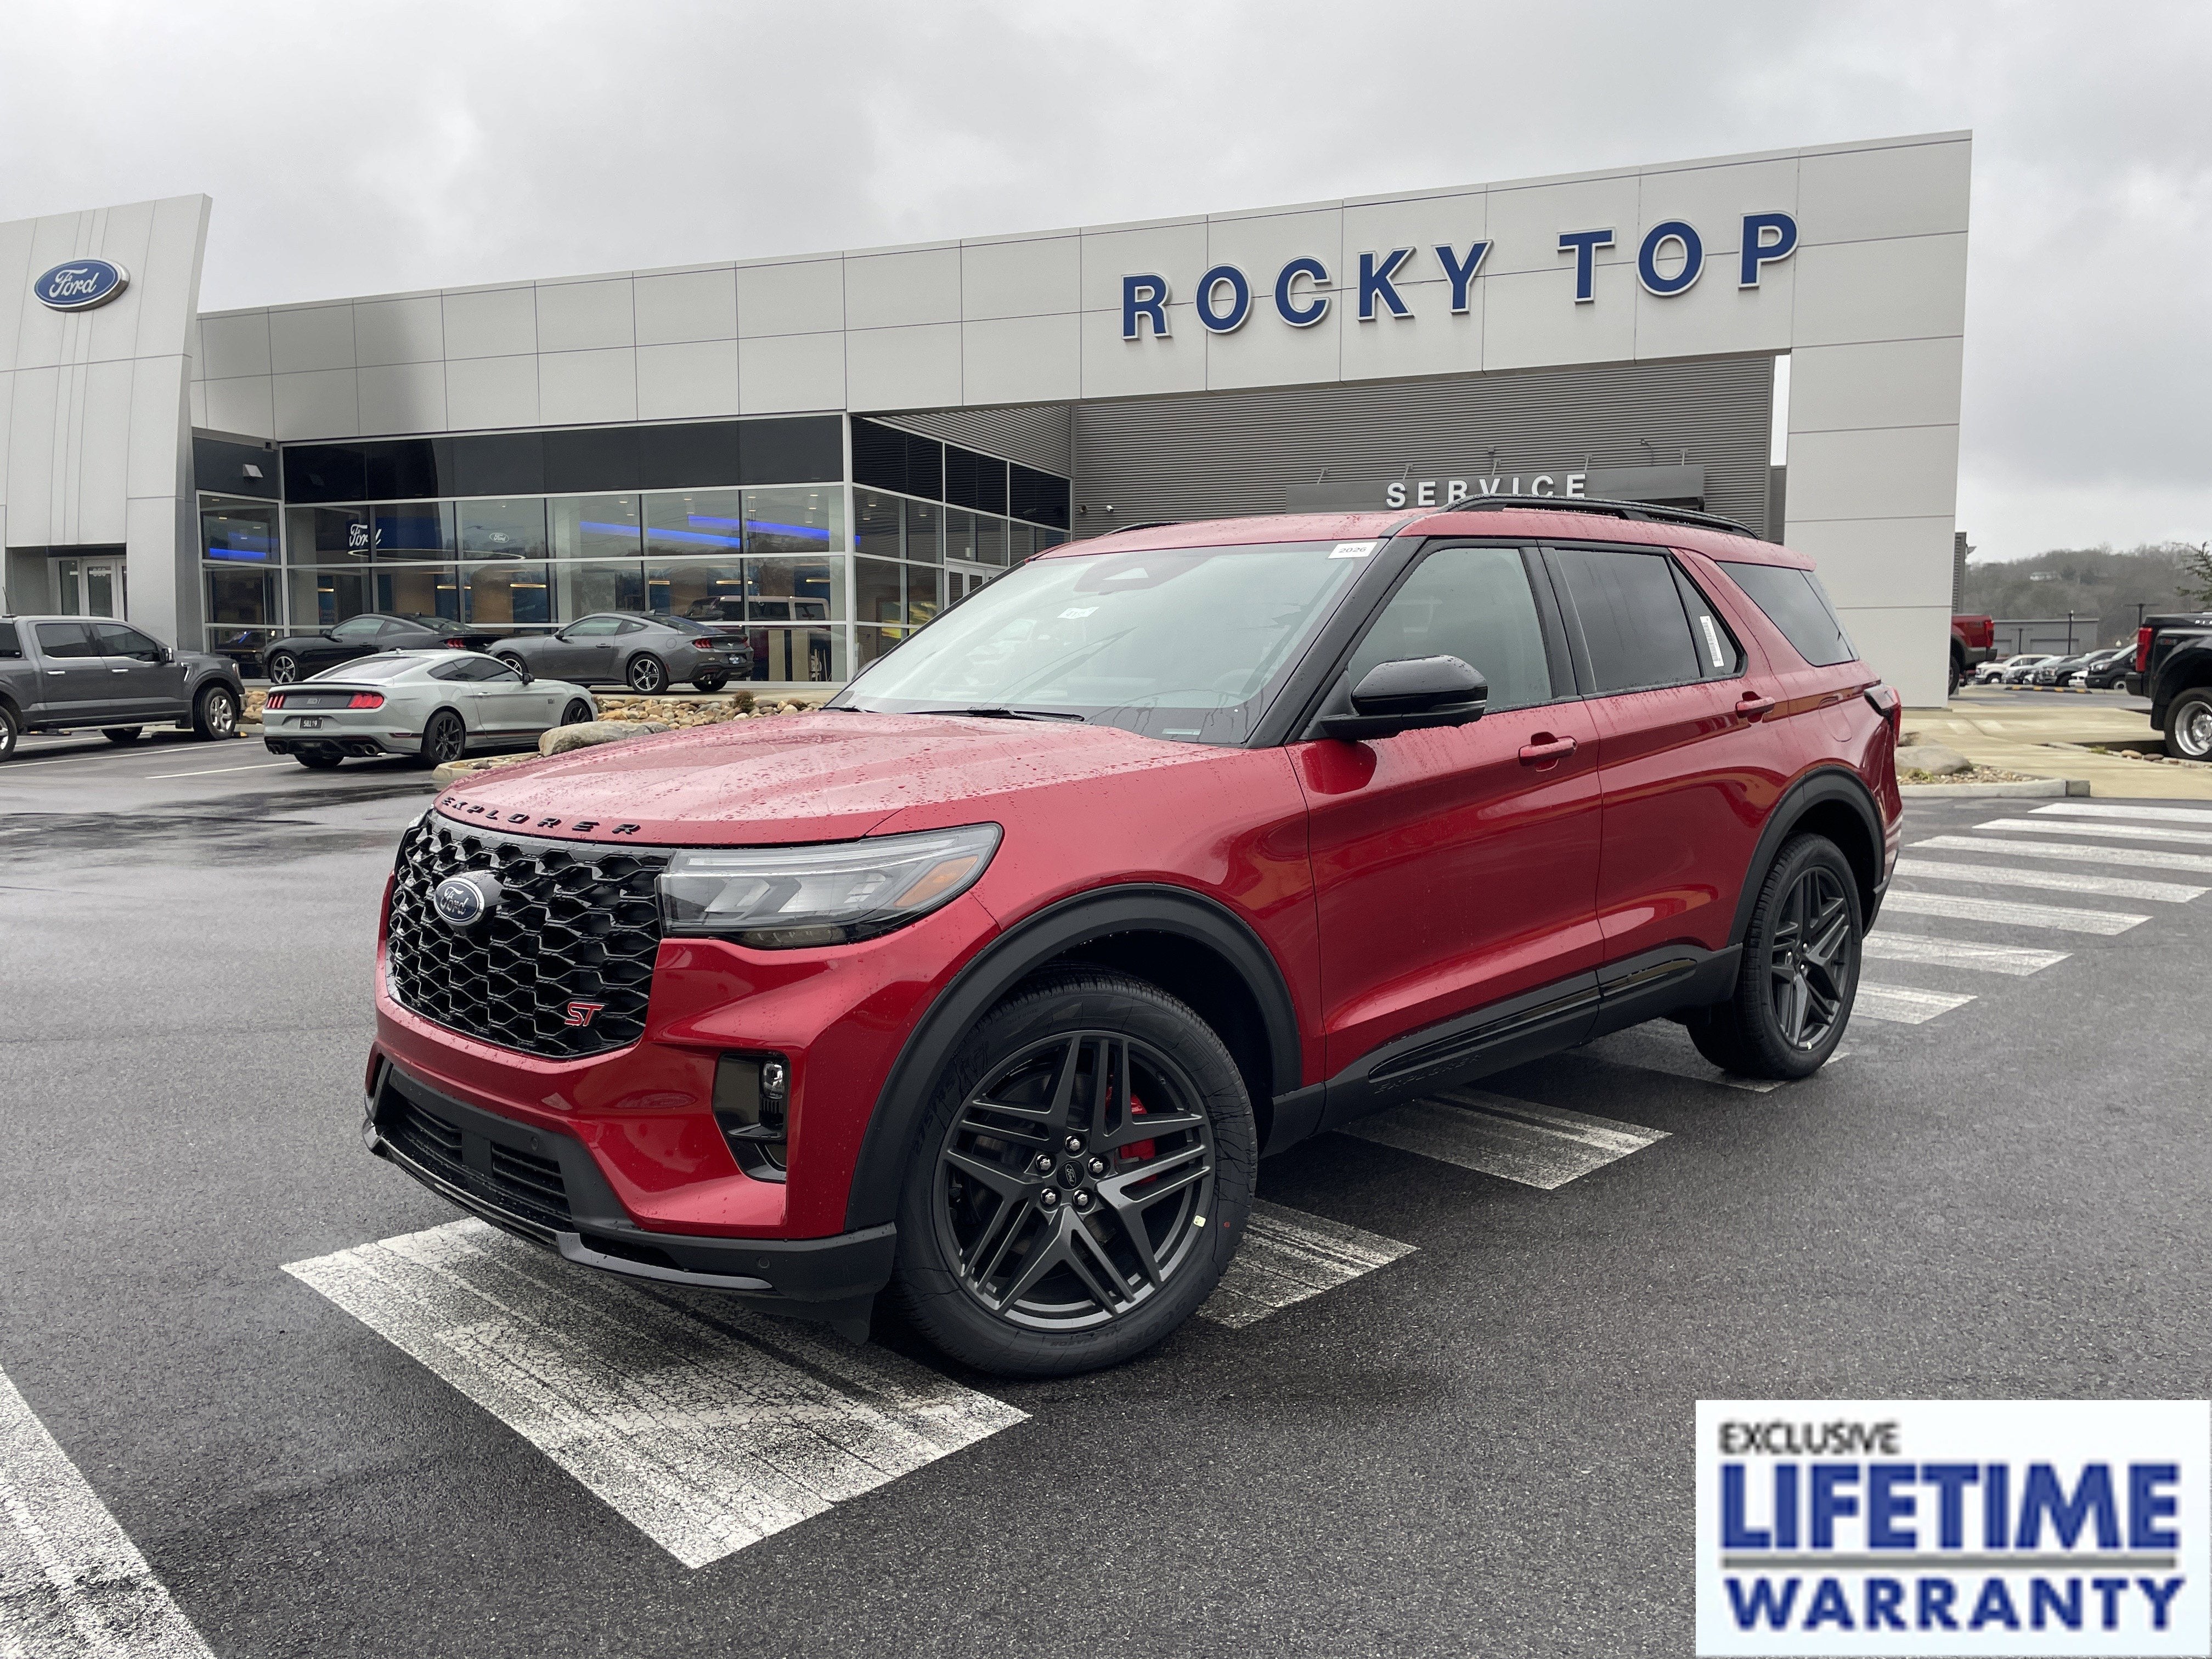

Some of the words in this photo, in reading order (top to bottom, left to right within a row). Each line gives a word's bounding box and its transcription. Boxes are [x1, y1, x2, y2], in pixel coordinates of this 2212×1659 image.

[48, 268, 100, 298] Ford
[1121, 239, 1493, 340] ROCKY
[1557, 212, 1799, 304] TOP
[1385, 473, 1588, 510] SERVICE
[441, 796, 641, 835] EXPLORER
[440, 886, 469, 915] Ford
[564, 1001, 605, 1027] ST
